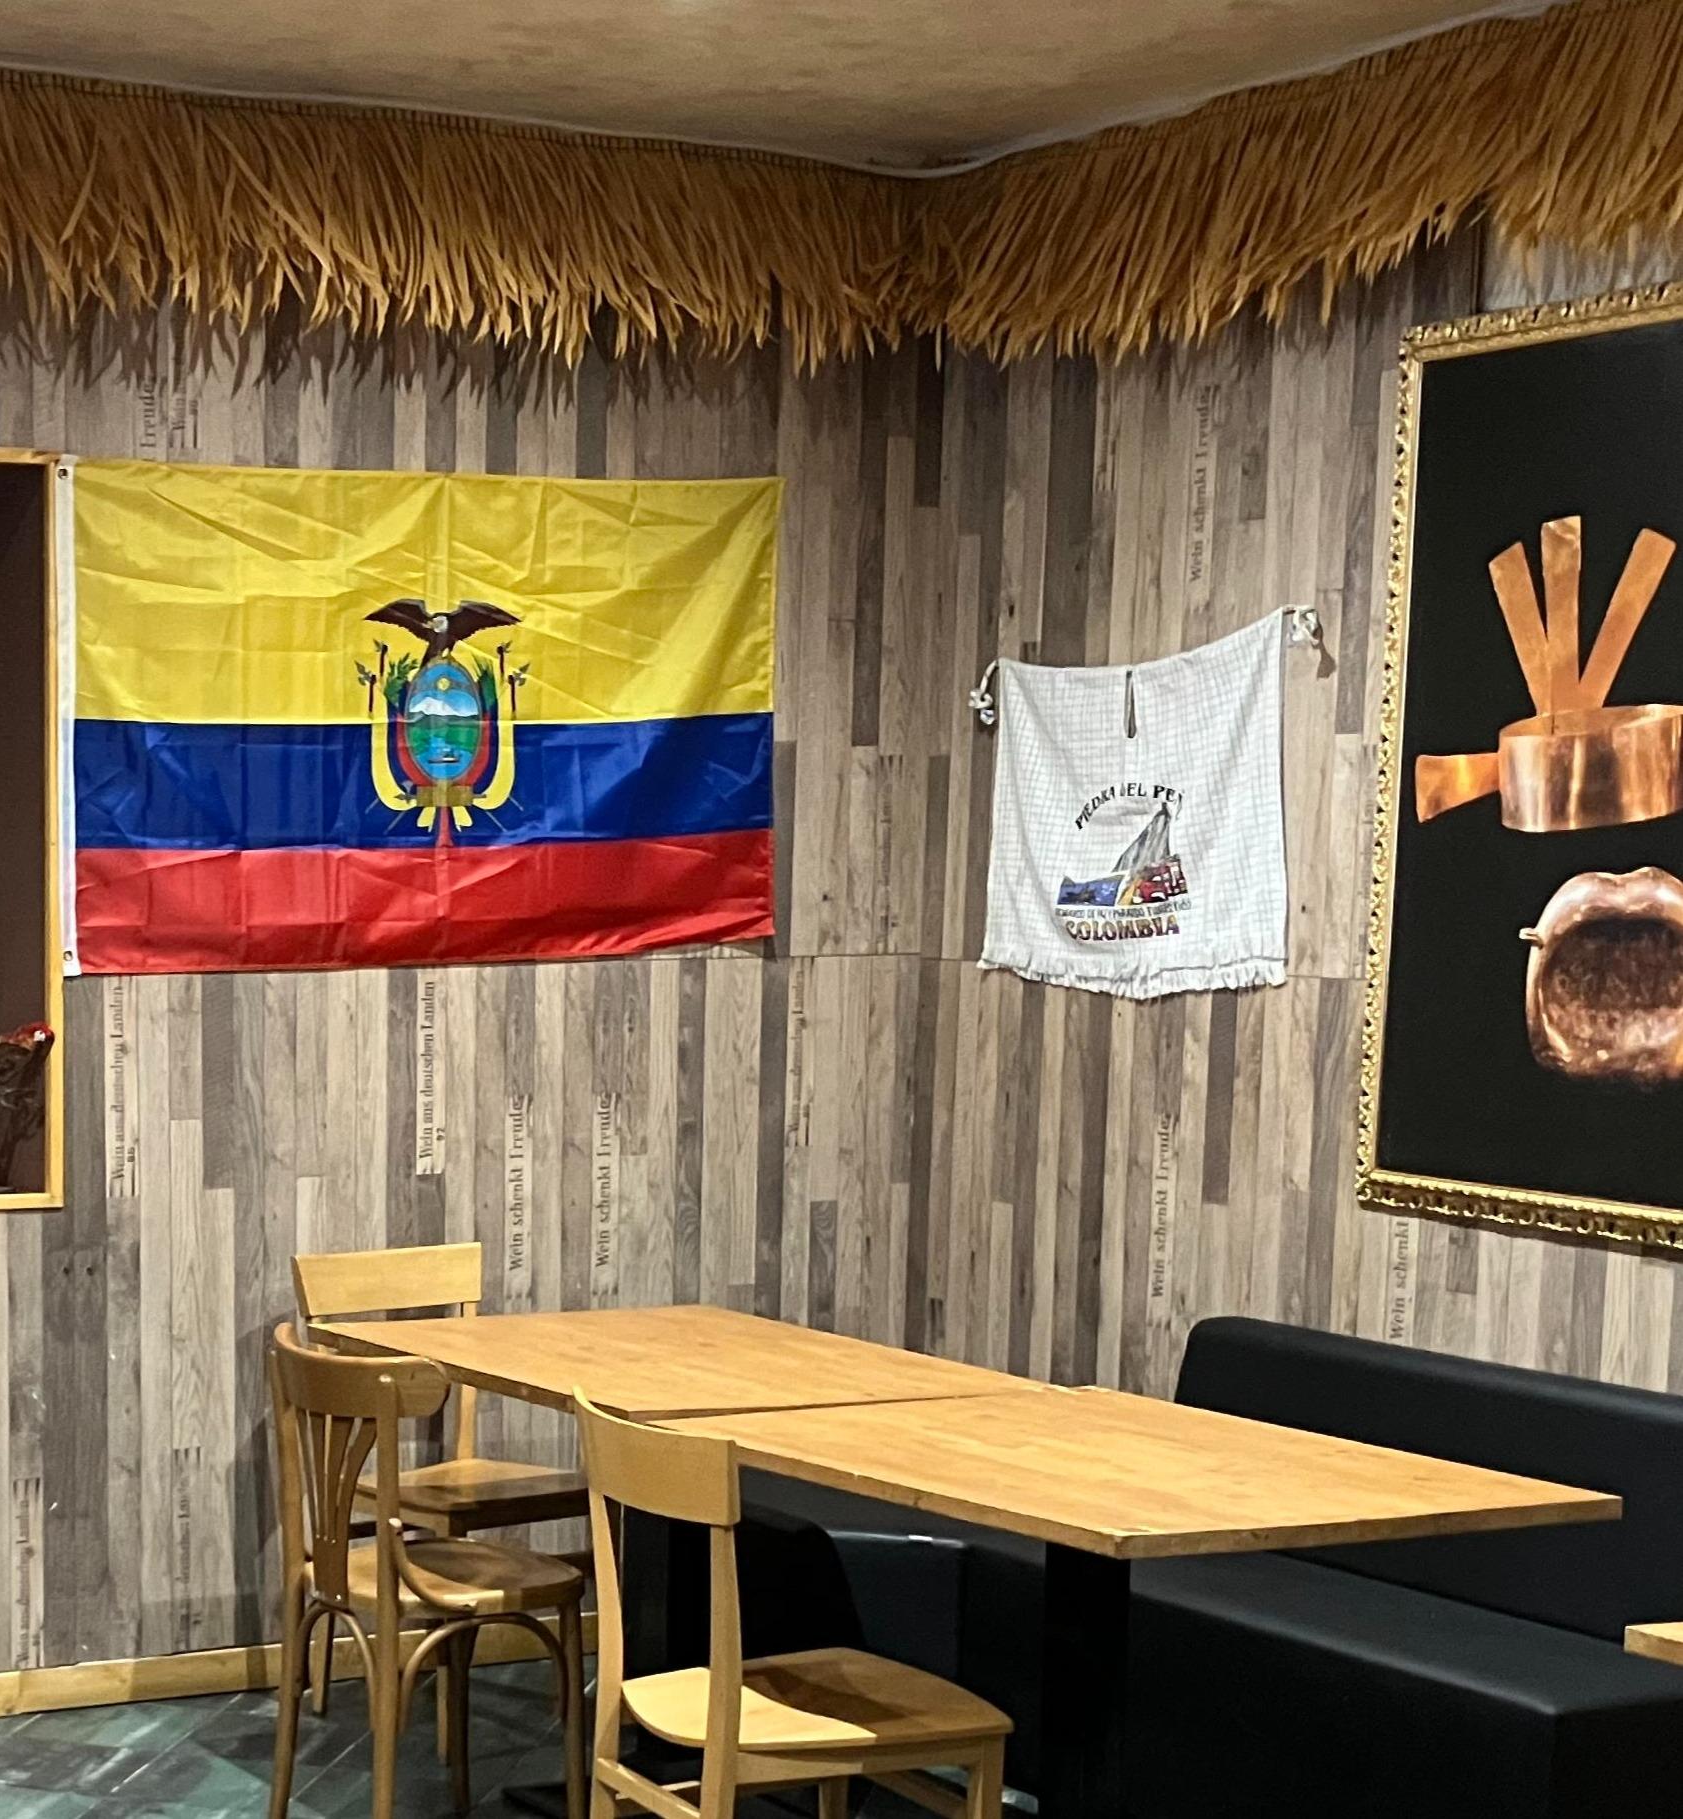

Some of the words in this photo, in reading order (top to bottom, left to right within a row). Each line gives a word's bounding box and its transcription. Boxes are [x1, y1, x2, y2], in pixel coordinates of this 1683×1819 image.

[1189, 540, 1204, 583] Wein
[1075, 785, 1117, 831] PIEDRA
[1065, 914, 1181, 941] COLOMBIA
[109, 985, 124, 1039] Landen
[420, 981, 435, 1030] Landen
[109, 1043, 125, 1113] deutschen
[420, 1033, 434, 1097] deutschen
[422, 1101, 434, 1124] aus
[419, 1127, 434, 1159] Wein
[436, 1127, 446, 1142] 92
[111, 1145, 125, 1180] Wein
[508, 1167, 524, 1226] schenkt
[596, 1165, 611, 1224] schenkt
[1153, 1190, 1167, 1253] schenkt
[508, 1232, 524, 1271] Wein
[595, 1229, 611, 1268] Wein
[1393, 1221, 1409, 1289] schenkt
[1151, 1258, 1165, 1298] Wein
[1389, 1297, 1405, 1339] Wein
